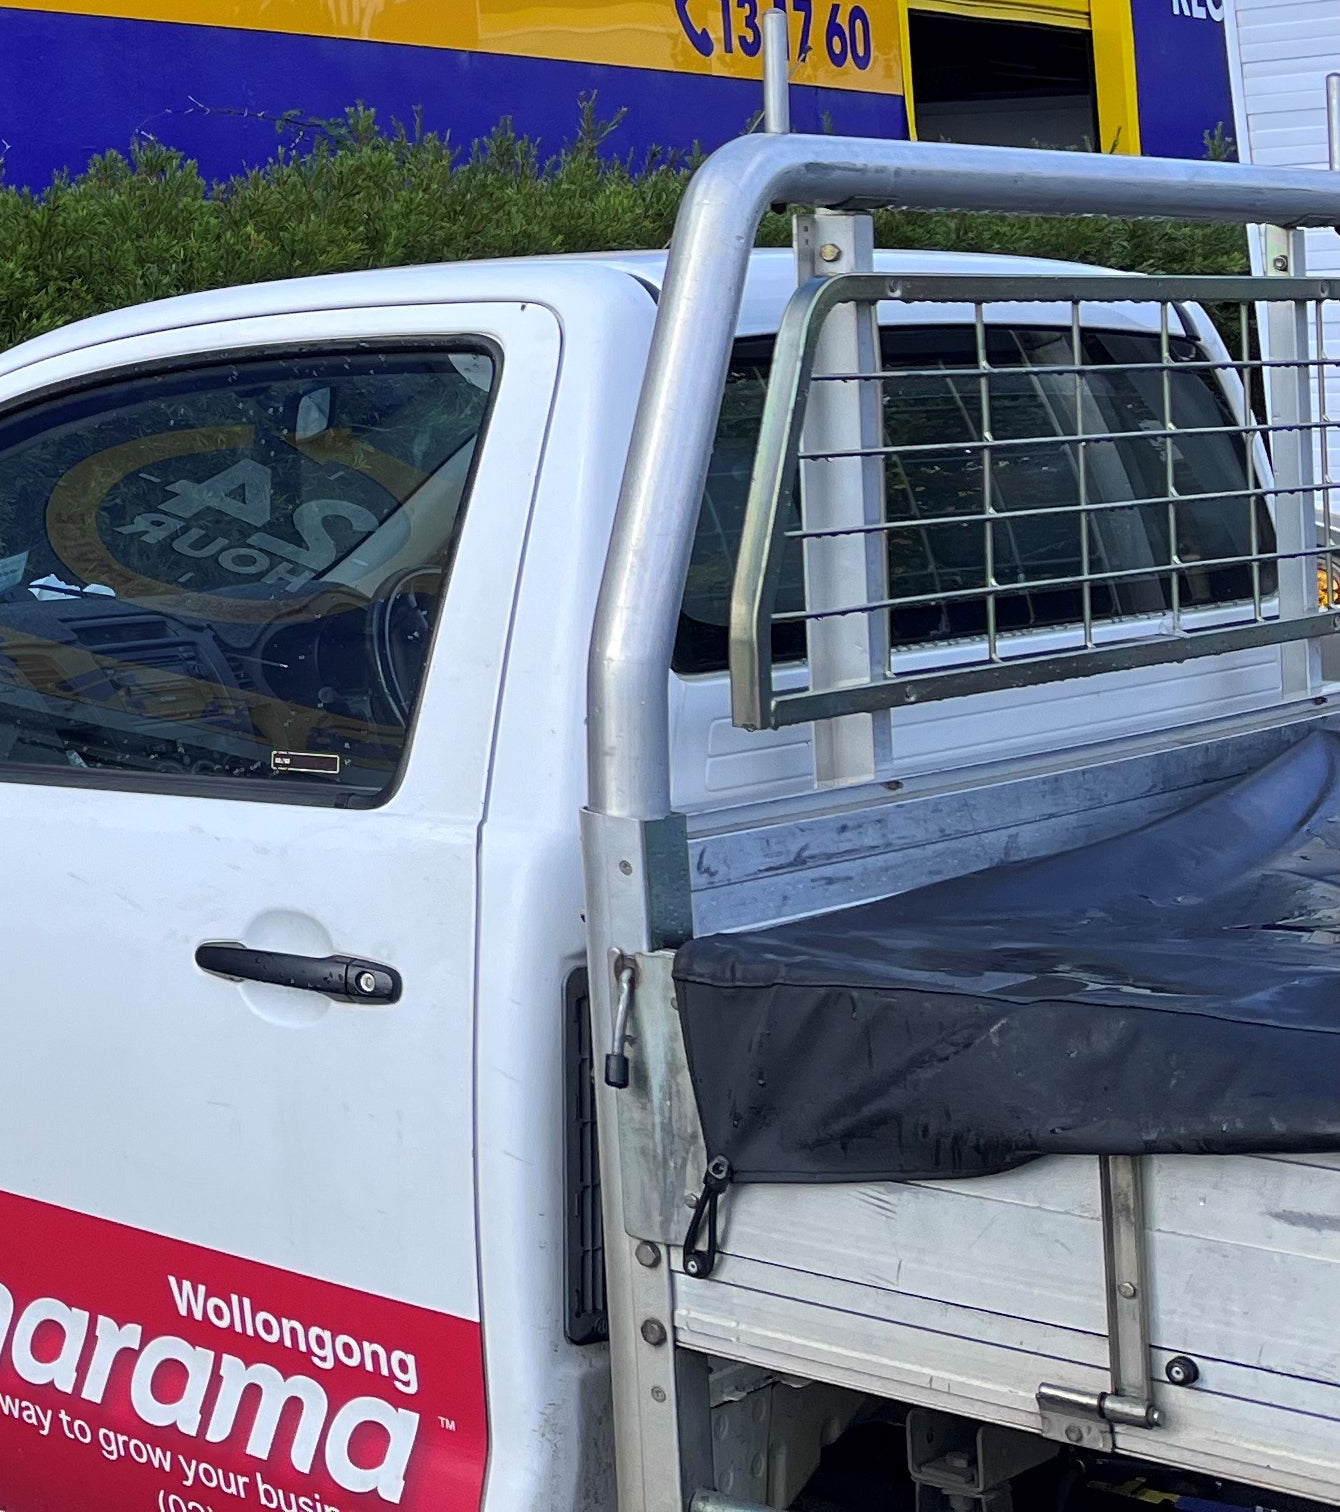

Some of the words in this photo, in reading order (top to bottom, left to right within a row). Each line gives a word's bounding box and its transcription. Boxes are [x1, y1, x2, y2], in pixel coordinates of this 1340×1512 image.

[825, 3, 872, 70] 60
[167, 1275, 420, 1393] Wollongong
[0, 1395, 53, 1435] way
[59, 1408, 92, 1445] to
[98, 1427, 172, 1473] grow
[177, 1454, 250, 1498] your
